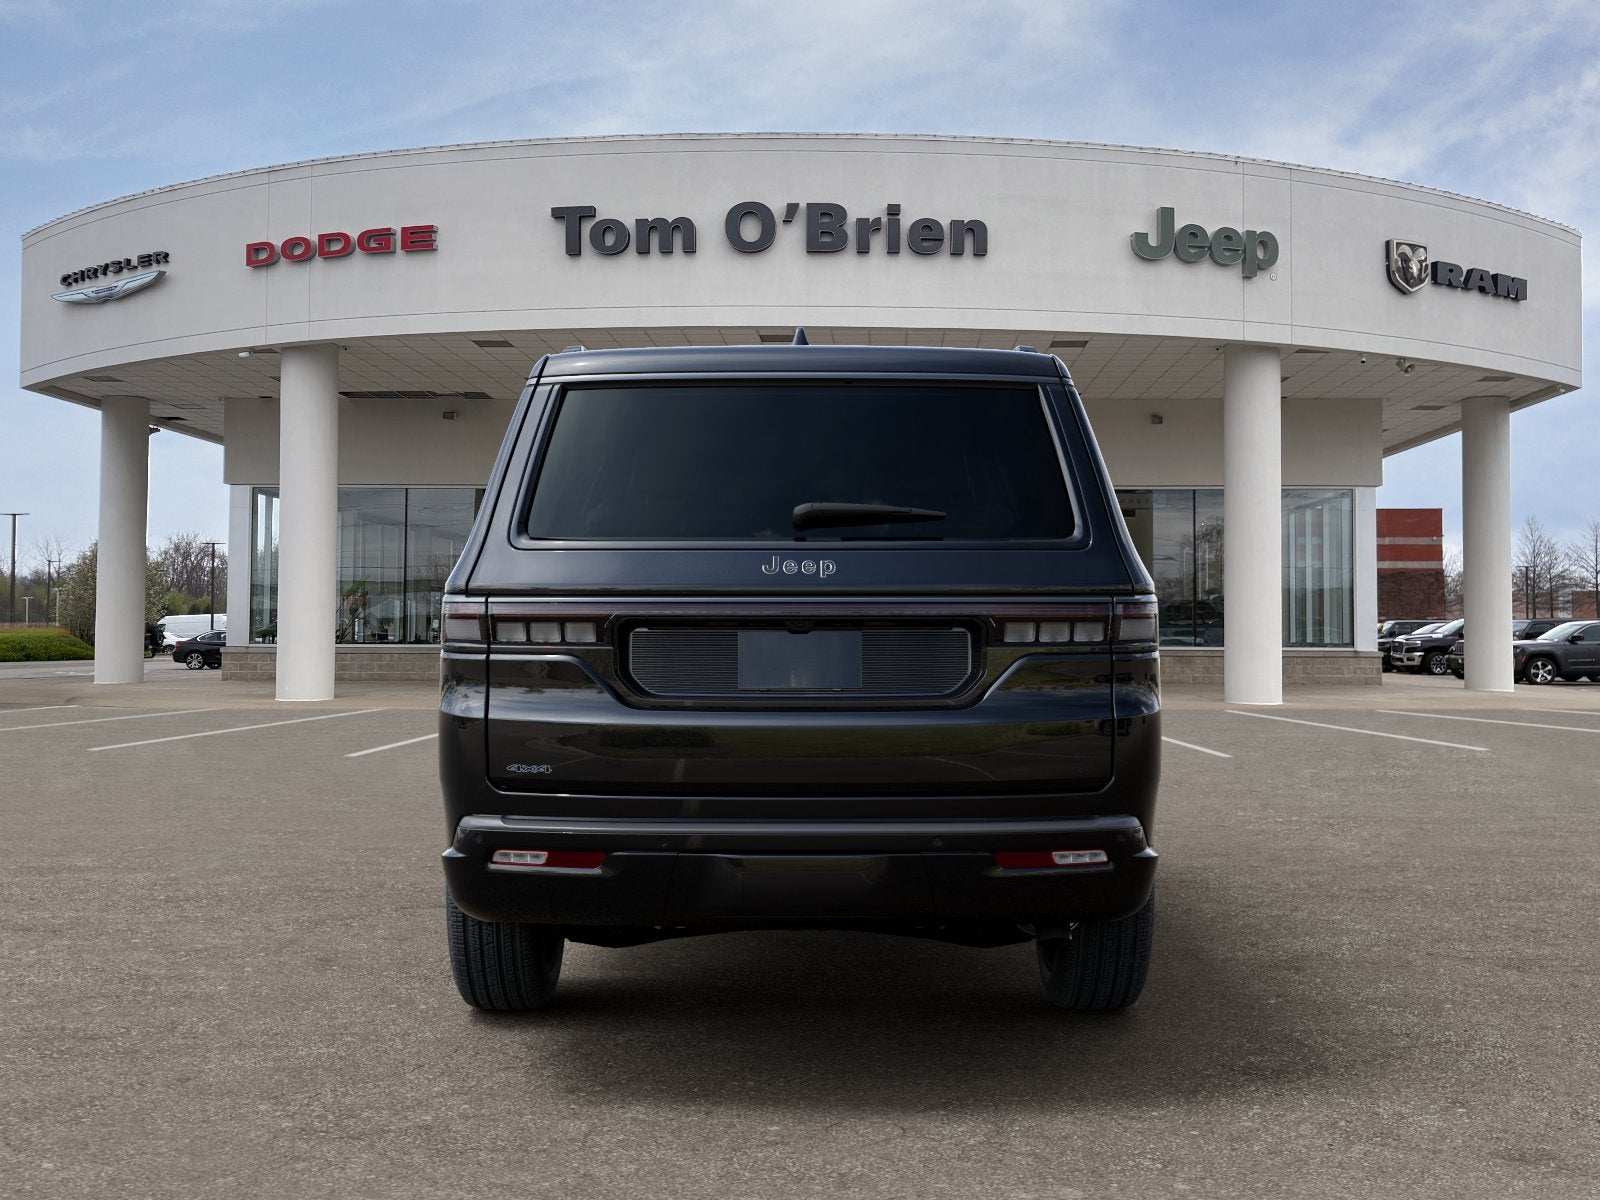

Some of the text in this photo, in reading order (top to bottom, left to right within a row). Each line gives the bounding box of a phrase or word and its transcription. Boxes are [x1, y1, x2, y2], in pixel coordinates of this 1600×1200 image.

[245, 225, 438, 268] DODGE
[551, 201, 988, 256] Tom O'Brien
[1130, 206, 1279, 279] Jeep
[59, 249, 170, 287] CHRYSLER
[1431, 261, 1528, 302] RAM
[762, 555, 837, 578] Jeep
